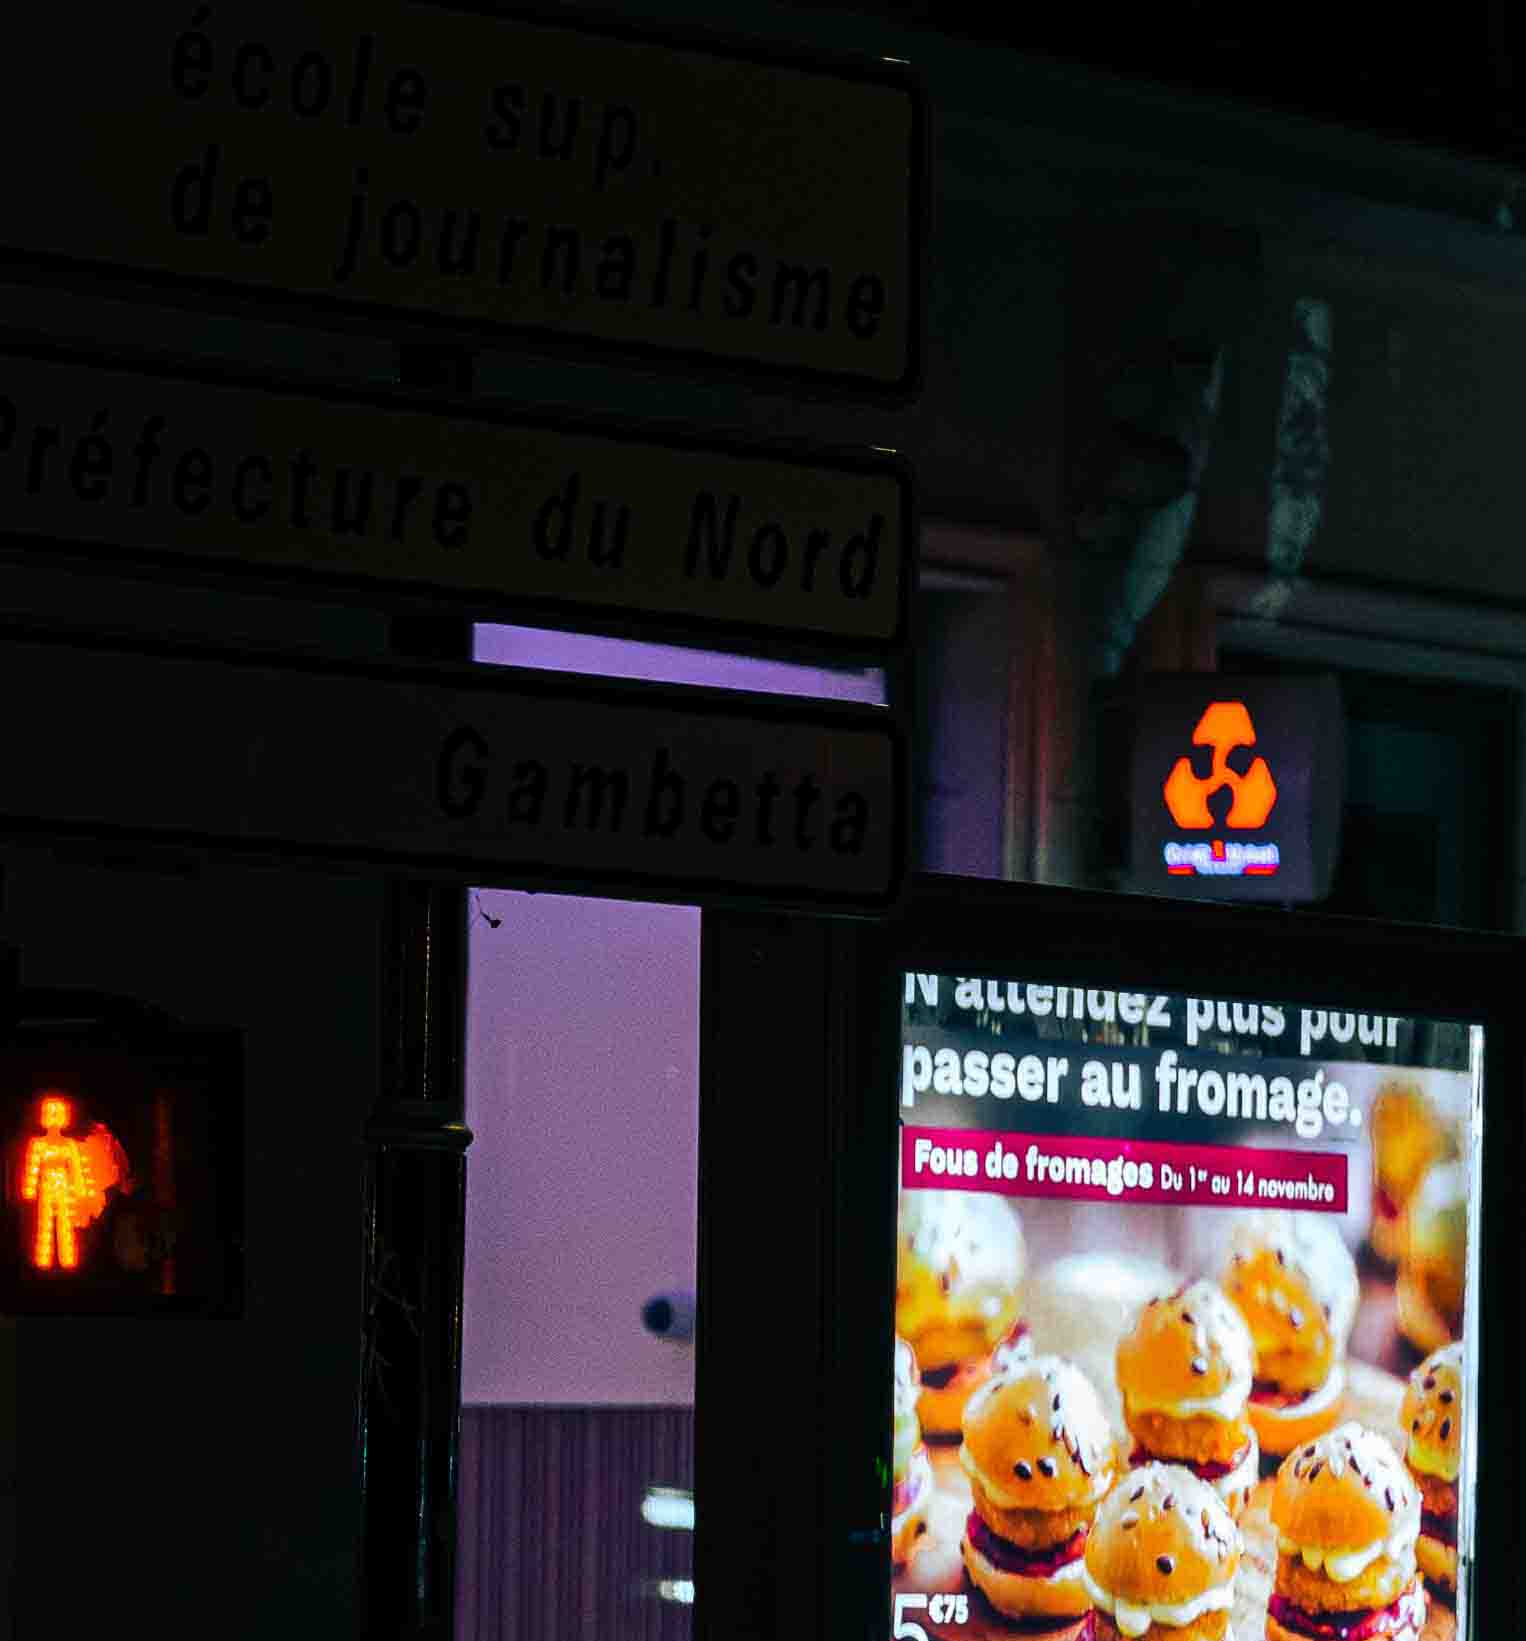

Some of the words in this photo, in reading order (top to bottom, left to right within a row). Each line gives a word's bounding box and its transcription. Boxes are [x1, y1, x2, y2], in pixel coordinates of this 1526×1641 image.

[171, 6, 429, 136] école
[486, 82, 662, 185] sup.
[171, 144, 274, 244] de
[335, 167, 887, 340] journalisme
[532, 473, 628, 571] du
[686, 490, 884, 599] Nord
[437, 726, 868, 855] Gambetta
[902, 1044, 1069, 1108] passer
[1081, 1059, 1141, 1110] au
[1155, 1050, 1362, 1139] fromage.
[1301, 1008, 1400, 1056] pour
[914, 1138, 978, 1176] Fous
[985, 1141, 1019, 1179] de
[1025, 1145, 1153, 1195] fromages
[1160, 1163, 1183, 1192] Du
[1211, 1173, 1231, 1195] au
[1236, 1169, 1254, 1197] 14
[1258, 1172, 1335, 1202] novembre
